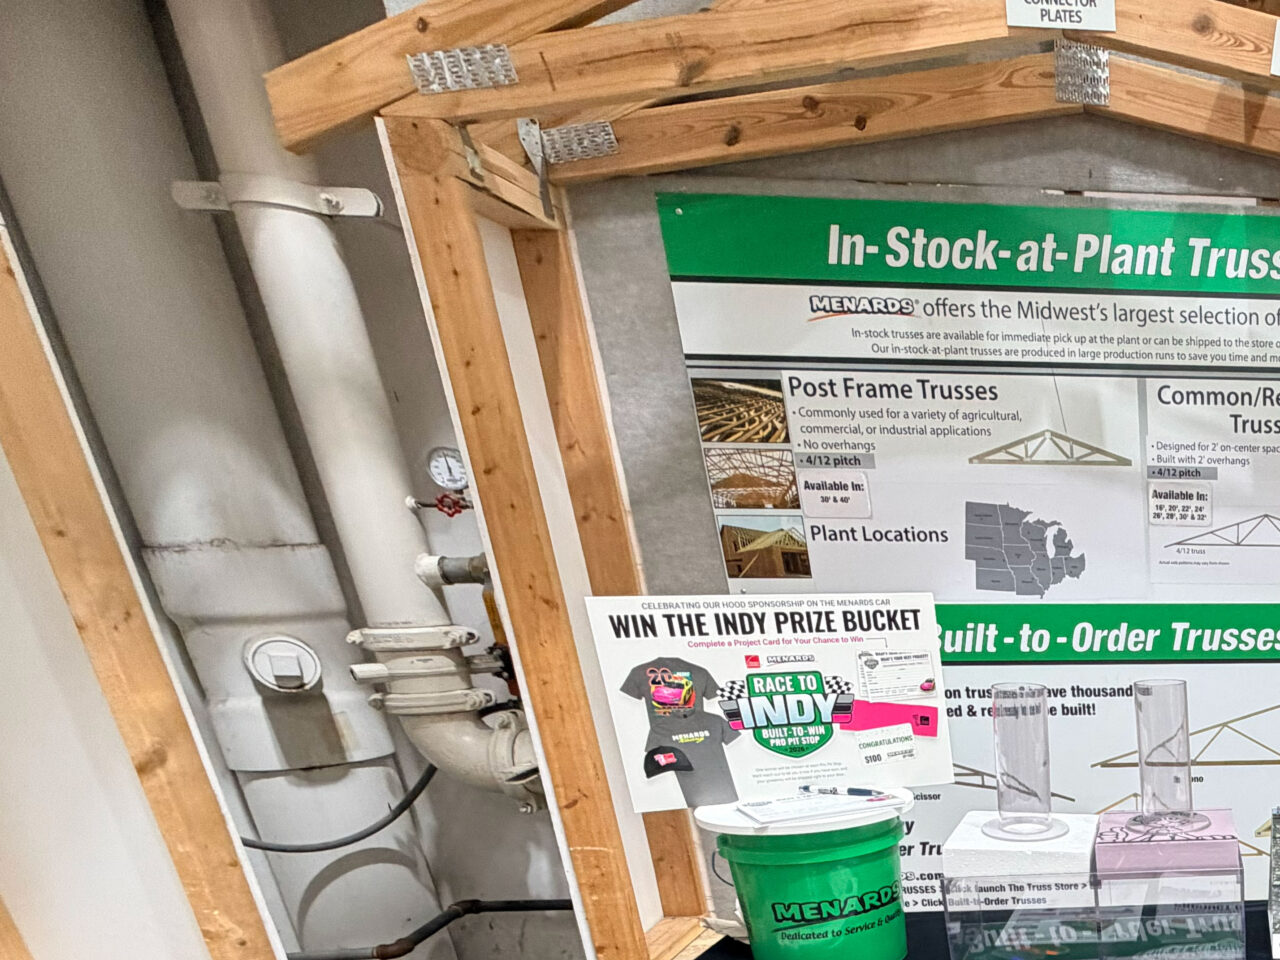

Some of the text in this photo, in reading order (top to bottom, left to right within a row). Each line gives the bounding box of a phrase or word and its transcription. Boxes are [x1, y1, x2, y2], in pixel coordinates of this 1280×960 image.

[1040, 8, 1083, 24] PLATES
[827, 223, 1175, 276] In-Stock-at-Plant
[808, 294, 919, 319] MENARDS
[922, 296, 976, 318] offers
[980, 298, 1011, 319] the
[1017, 299, 1108, 322] Midwest's
[1112, 301, 1174, 327] largest
[1179, 304, 1259, 325] selection
[788, 375, 998, 401] Post Frame Trusses
[797, 405, 1022, 423] Commonly used for a variety of agricultural,
[799, 423, 992, 438] commercial, or industrial applications
[802, 438, 876, 453] No overhangs
[1155, 440, 1196, 453] Designed
[1197, 440, 1210, 452] for
[1210, 441, 1219, 452] 2'
[1219, 443, 1260, 453] on-center
[805, 454, 861, 468] 4/12 pitch
[1156, 453, 1250, 468] Built with 2' overhangs
[1156, 467, 1201, 479] 4/12 pitch
[803, 479, 864, 492] Available In:
[1151, 488, 1208, 501] Available In:
[810, 524, 948, 542] Plant Locations
[641, 597, 891, 610] CELEBRATING OUR HOOD SPONSORSHIP ON THE MENARDS CAR
[608, 608, 920, 638] WIN THE INDY PRIZE BUCKET
[686, 639, 726, 649] Complete
[733, 638, 762, 648] Project
[761, 637, 781, 646] Card
[781, 637, 792, 645] for
[792, 637, 811, 645] Your
[811, 636, 840, 644] Chance
[840, 635, 849, 643] to
[849, 635, 864, 643] Win
[766, 654, 815, 664] MENARDS
[752, 675, 817, 693] RACE TO
[737, 693, 838, 729] INDY
[761, 724, 826, 739] BUILT-TO-WIN
[769, 734, 820, 747] PRO PIT STOP
[858, 734, 913, 750] CONGRATULATIONS
[864, 753, 882, 764] $100
[771, 880, 900, 923] MENARDS
[780, 929, 829, 941] Dedicated
[831, 928, 842, 938] to
[844, 920, 876, 936] Service
[876, 918, 884, 928] &
